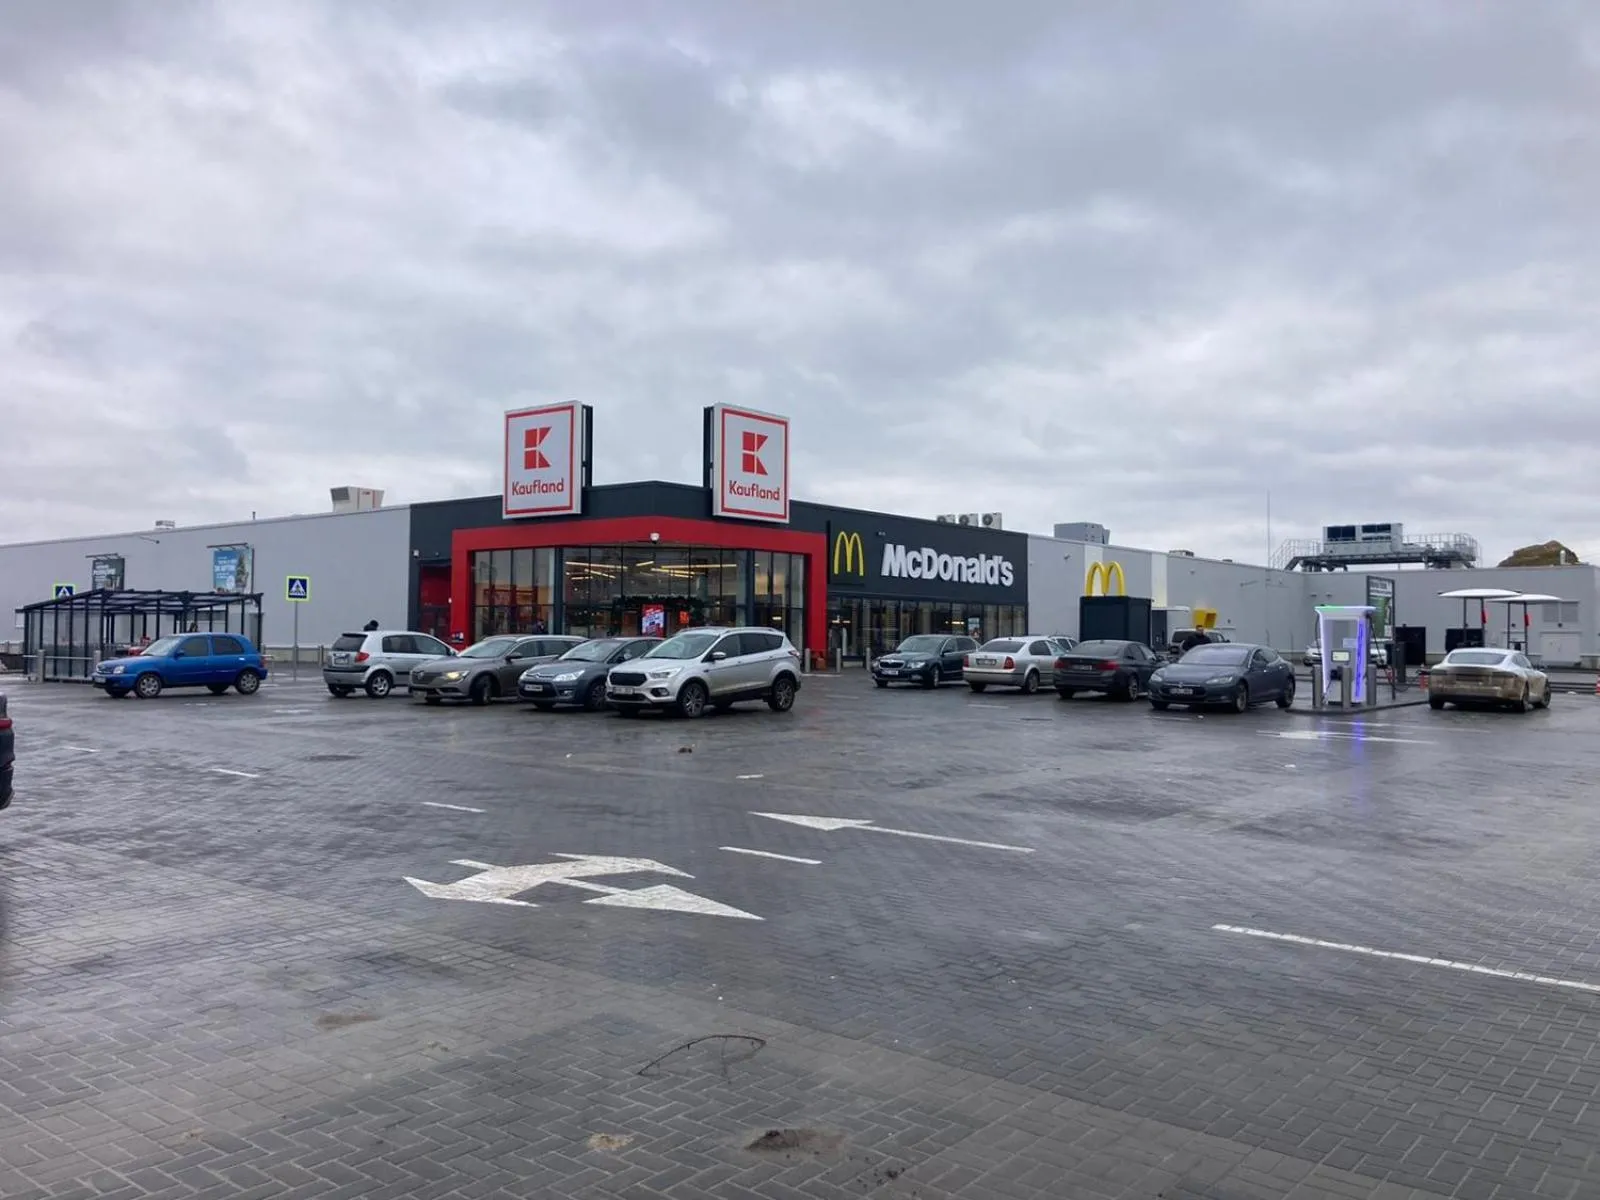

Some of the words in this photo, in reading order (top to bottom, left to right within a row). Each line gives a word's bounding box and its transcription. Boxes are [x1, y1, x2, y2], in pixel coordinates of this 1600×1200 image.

[511, 478, 565, 496] Kaufland
[728, 480, 780, 501] Kaufland
[880, 543, 1014, 588] McDonald's
